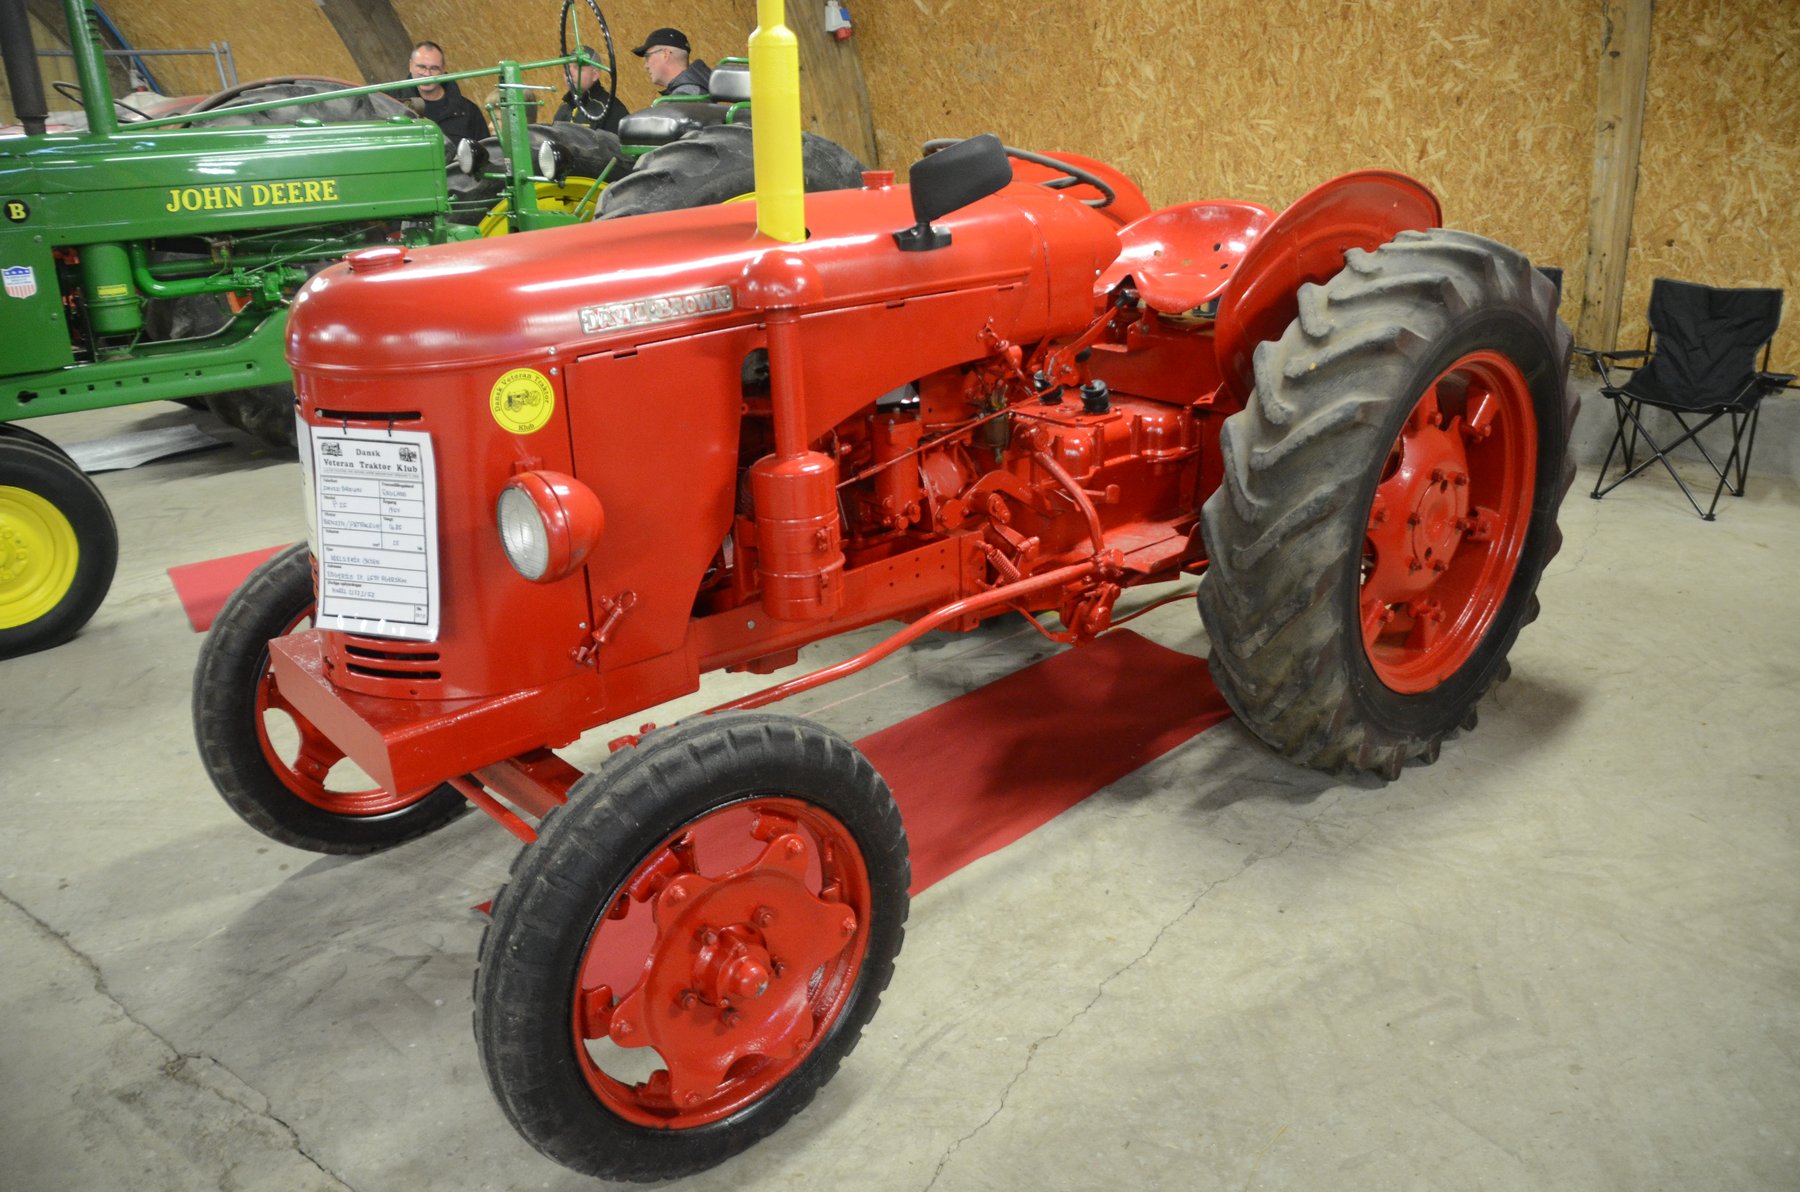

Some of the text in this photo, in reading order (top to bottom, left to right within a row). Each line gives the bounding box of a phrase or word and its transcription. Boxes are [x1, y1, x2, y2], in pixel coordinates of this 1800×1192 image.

[166, 180, 338, 213] JOHN DEERE
[8, 203, 26, 219] B
[654, 290, 729, 318] BROWN
[494, 373, 549, 412] Dansk Veteran Traktor
[356, 448, 381, 457] Dansk
[323, 459, 354, 468] Veteran
[359, 461, 391, 471] Traktor
[397, 464, 418, 473] Klub
